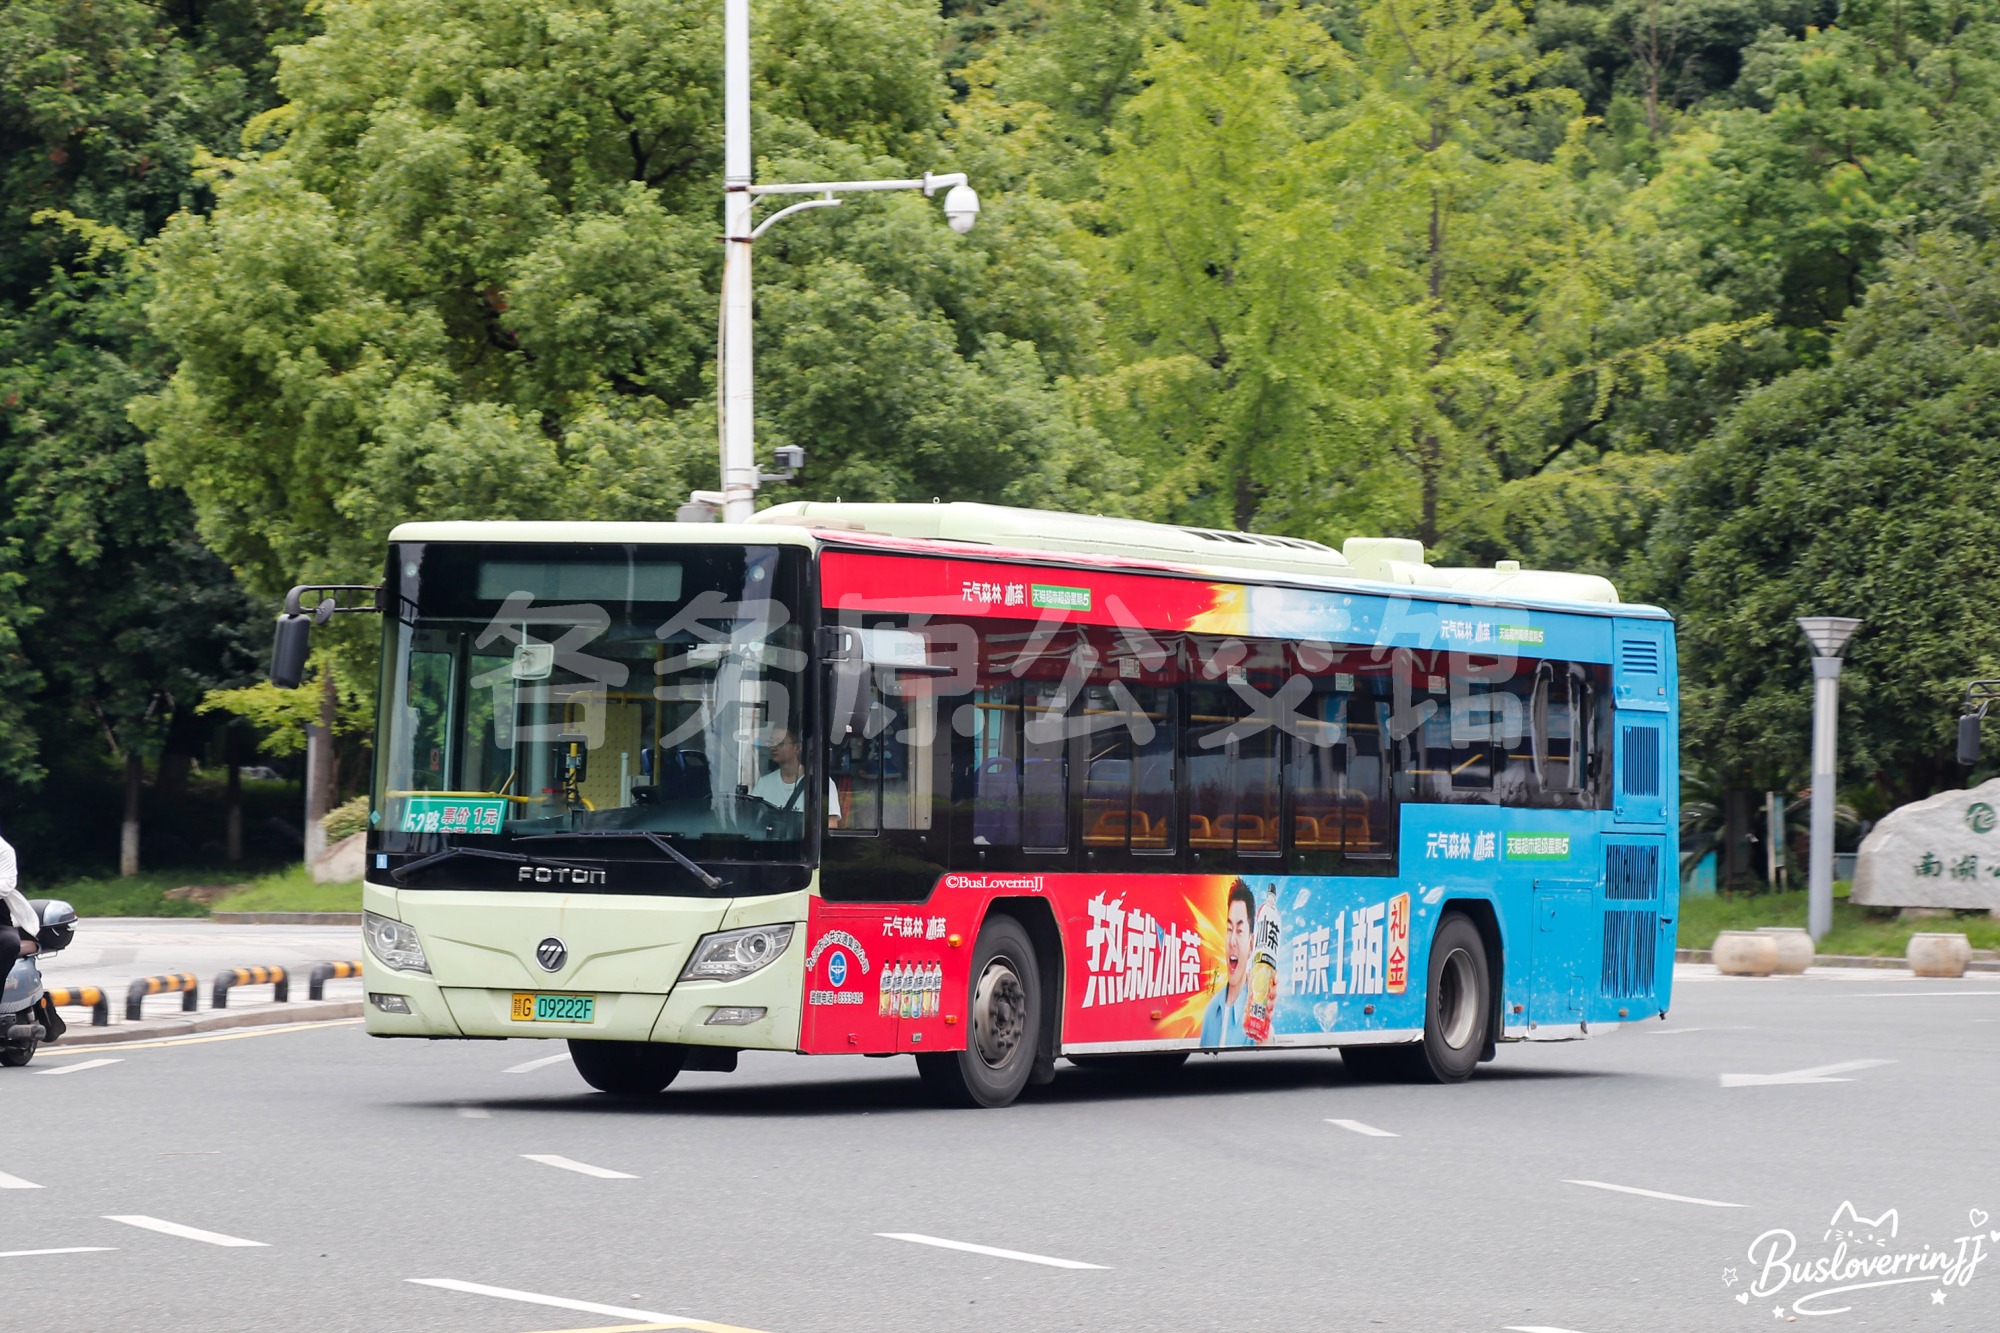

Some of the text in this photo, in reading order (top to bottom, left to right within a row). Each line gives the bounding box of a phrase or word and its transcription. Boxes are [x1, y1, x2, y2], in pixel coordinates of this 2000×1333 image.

[962, 581, 1002, 605] 元气森林
[1426, 832, 1471, 860] 元气森林
[518, 866, 606, 885] FOTON
[882, 915, 924, 938] 元气森林
[1081, 889, 1202, 1009] 热就冰茶
[1291, 902, 1386, 995] 再来1瓶
[1389, 901, 1406, 986] 礼金
[538, 998, 593, 1019] 09222F
